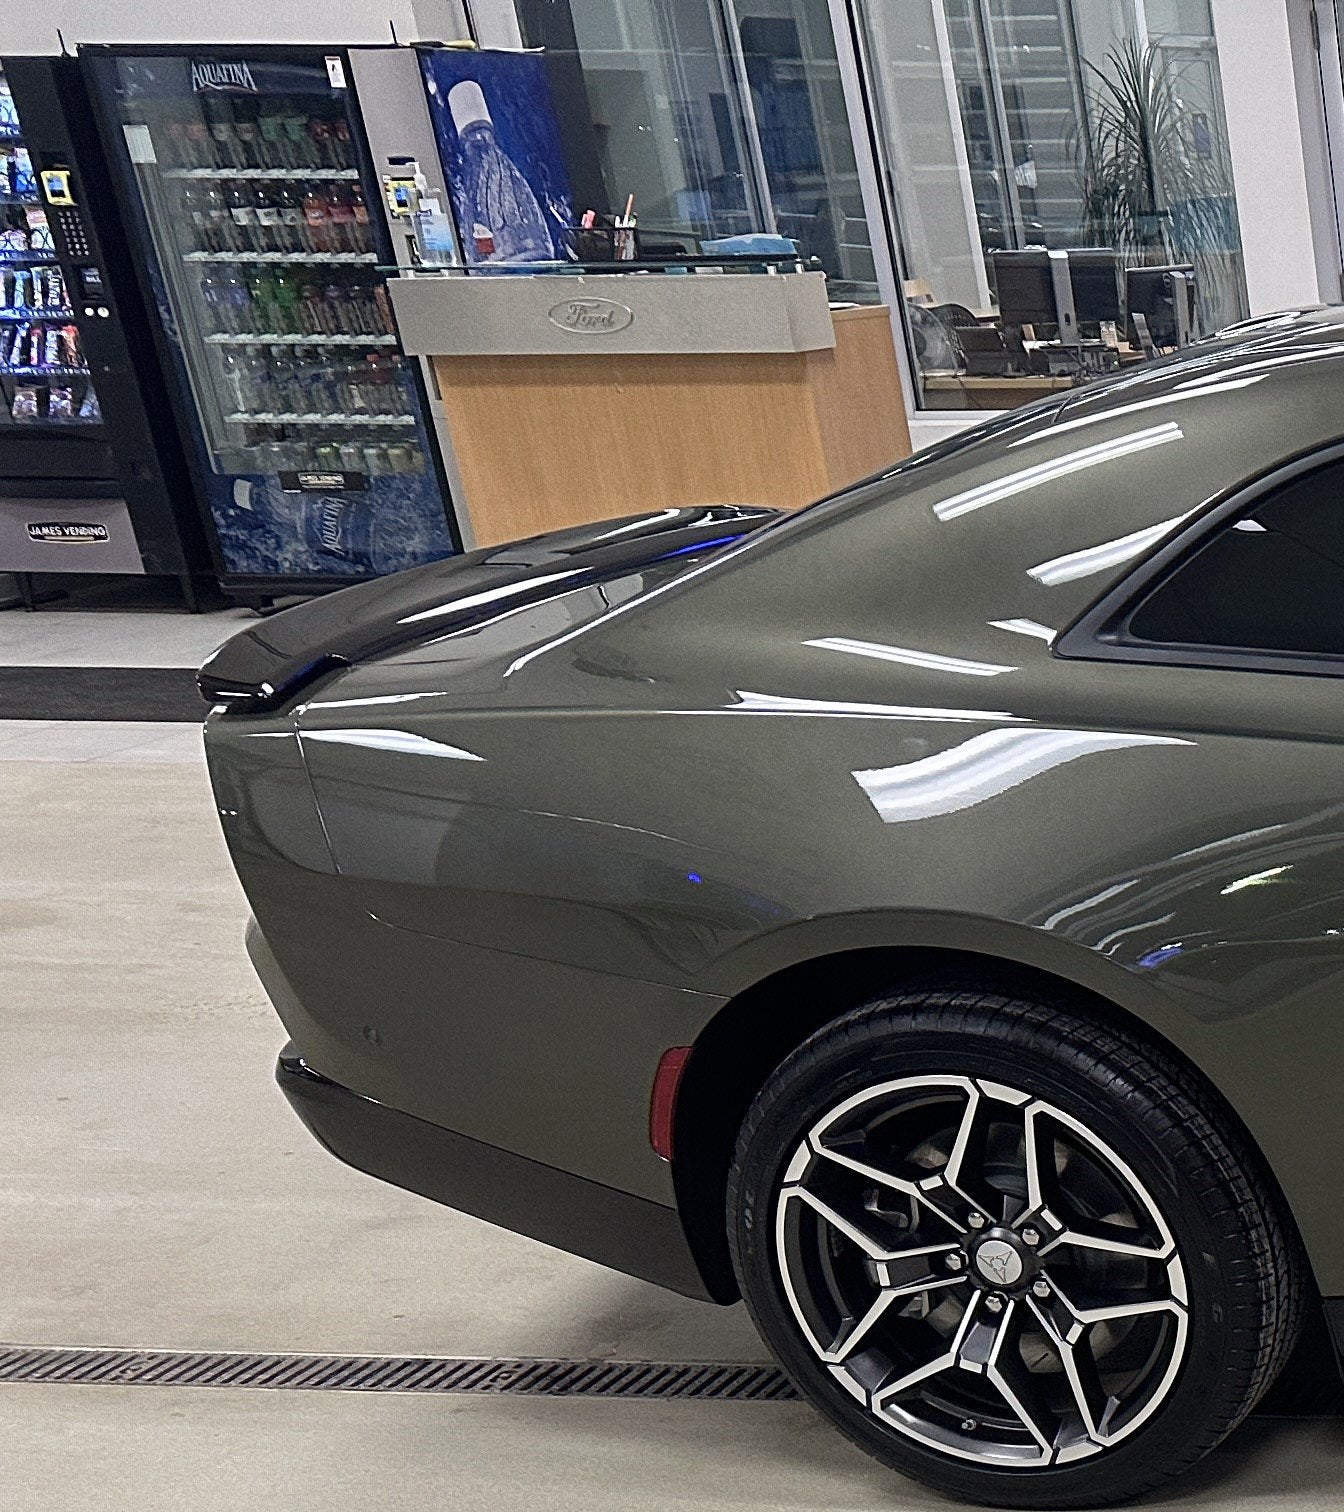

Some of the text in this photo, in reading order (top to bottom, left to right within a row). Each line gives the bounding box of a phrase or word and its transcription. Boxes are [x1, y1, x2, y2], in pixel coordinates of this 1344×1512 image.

[191, 60, 259, 92] AQUAFINA
[565, 302, 617, 329] Ford
[29, 526, 106, 537] JAMES VENDING
